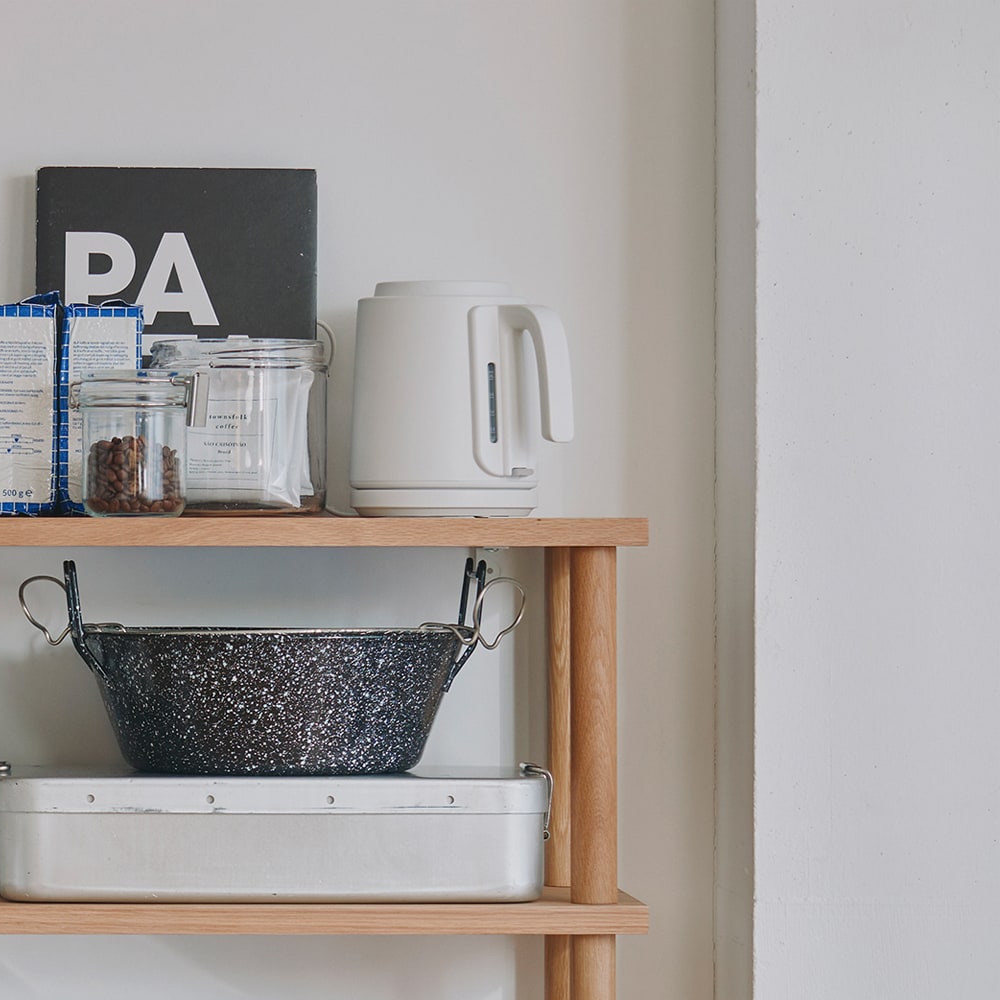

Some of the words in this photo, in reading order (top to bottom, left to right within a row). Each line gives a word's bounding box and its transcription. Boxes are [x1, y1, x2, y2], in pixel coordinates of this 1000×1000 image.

[65, 231, 220, 326] PA
[2, 489, 17, 497] 500
[18, 490, 24, 498] g
